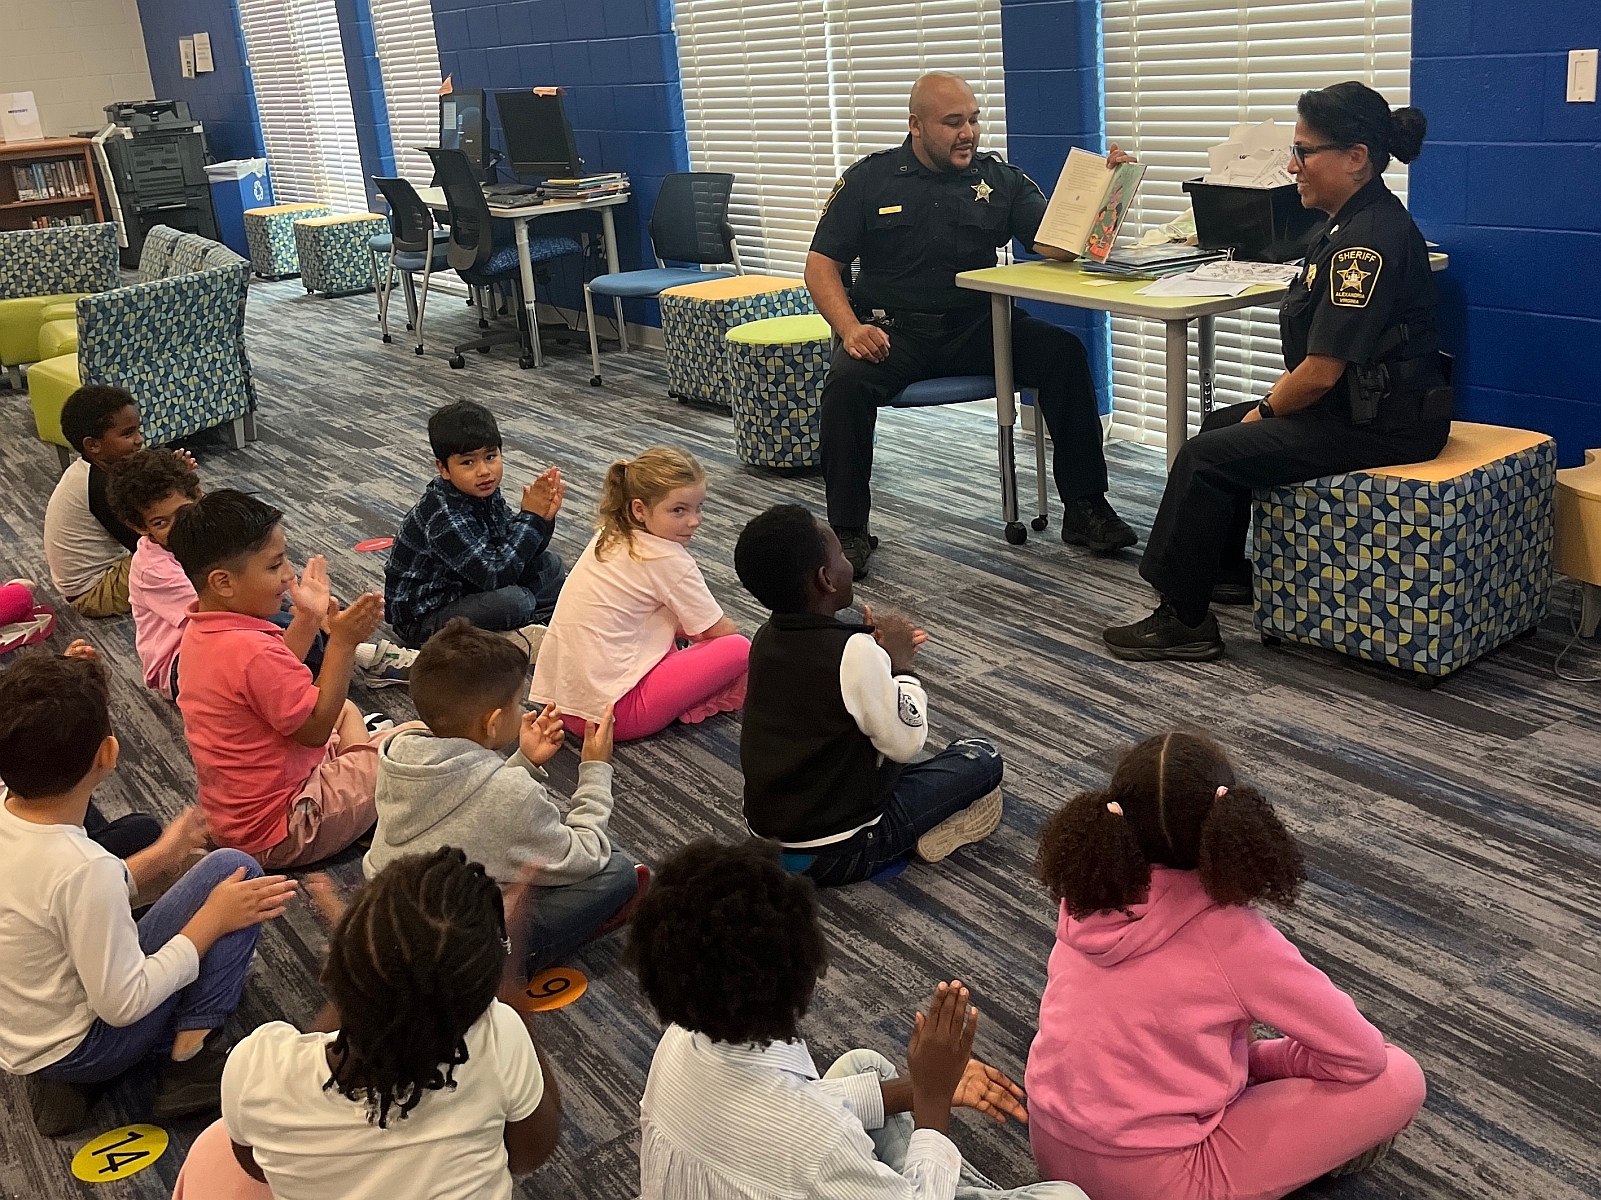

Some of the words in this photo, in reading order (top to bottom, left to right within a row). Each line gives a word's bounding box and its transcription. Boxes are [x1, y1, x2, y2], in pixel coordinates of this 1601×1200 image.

[1338, 251, 1377, 262] SHERIFF
[526, 977, 570, 998] 9
[92, 1131, 150, 1174] 14
